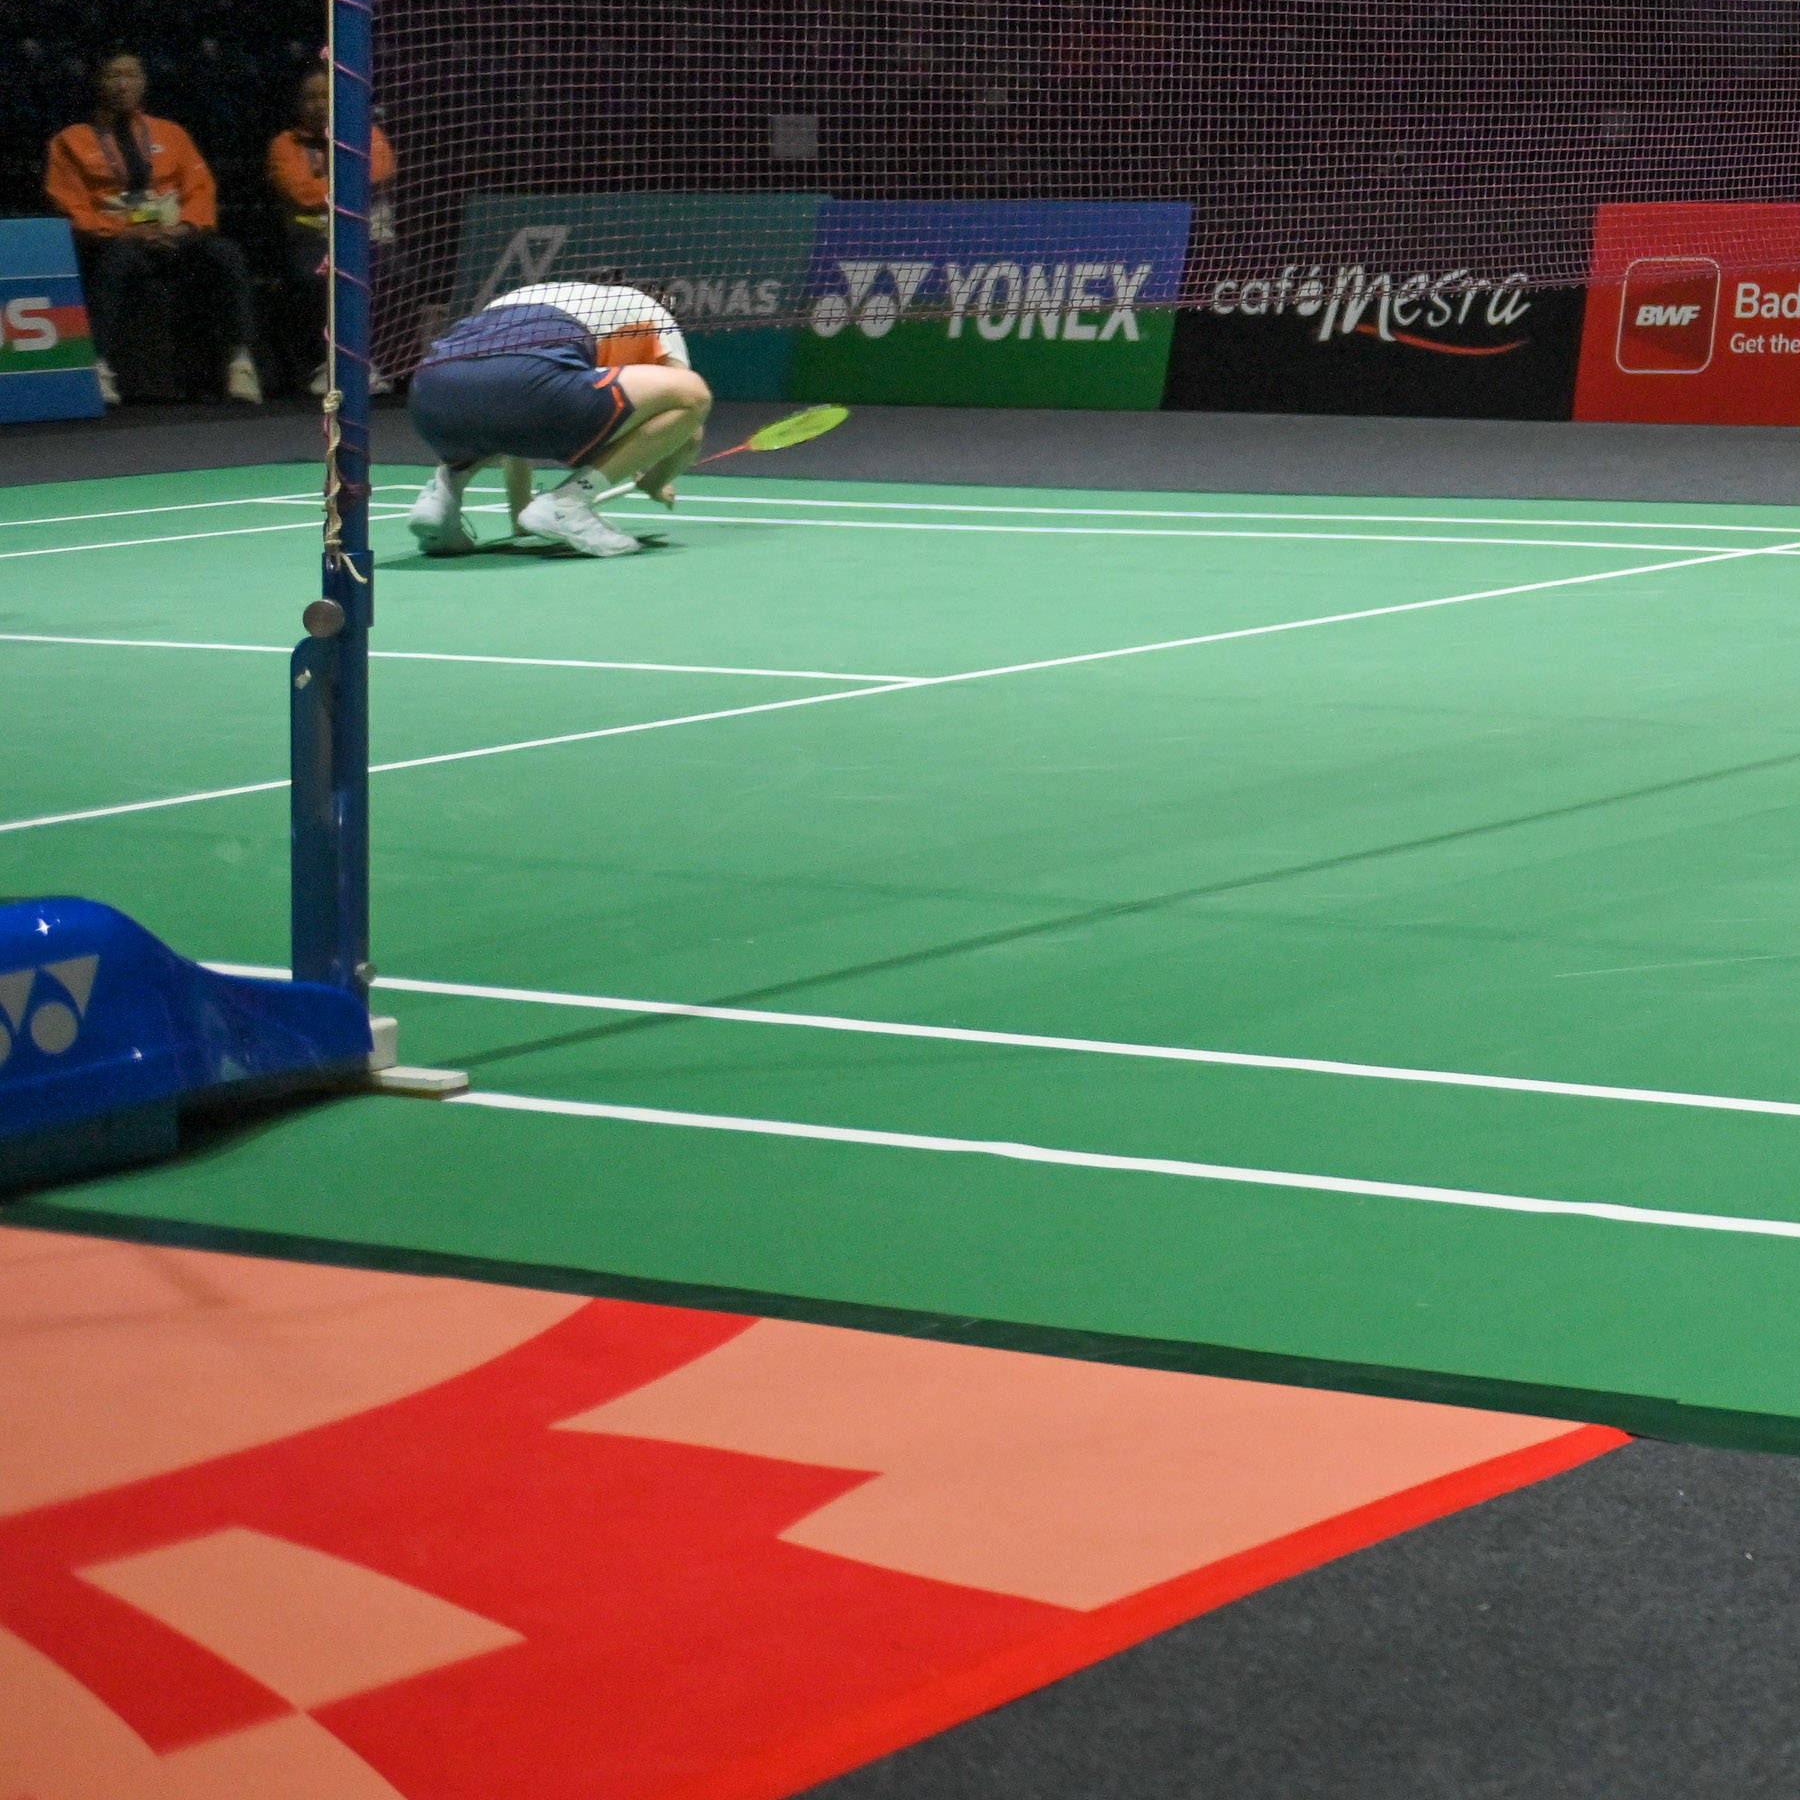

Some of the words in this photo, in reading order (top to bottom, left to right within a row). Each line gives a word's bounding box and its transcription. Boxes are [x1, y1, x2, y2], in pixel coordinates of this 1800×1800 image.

[666, 279, 782, 315] ONAS
[944, 262, 1151, 342] YONEX
[1635, 305, 1700, 326] BWF
[1730, 333, 1764, 354] Get
[1770, 333, 1800, 354] the
